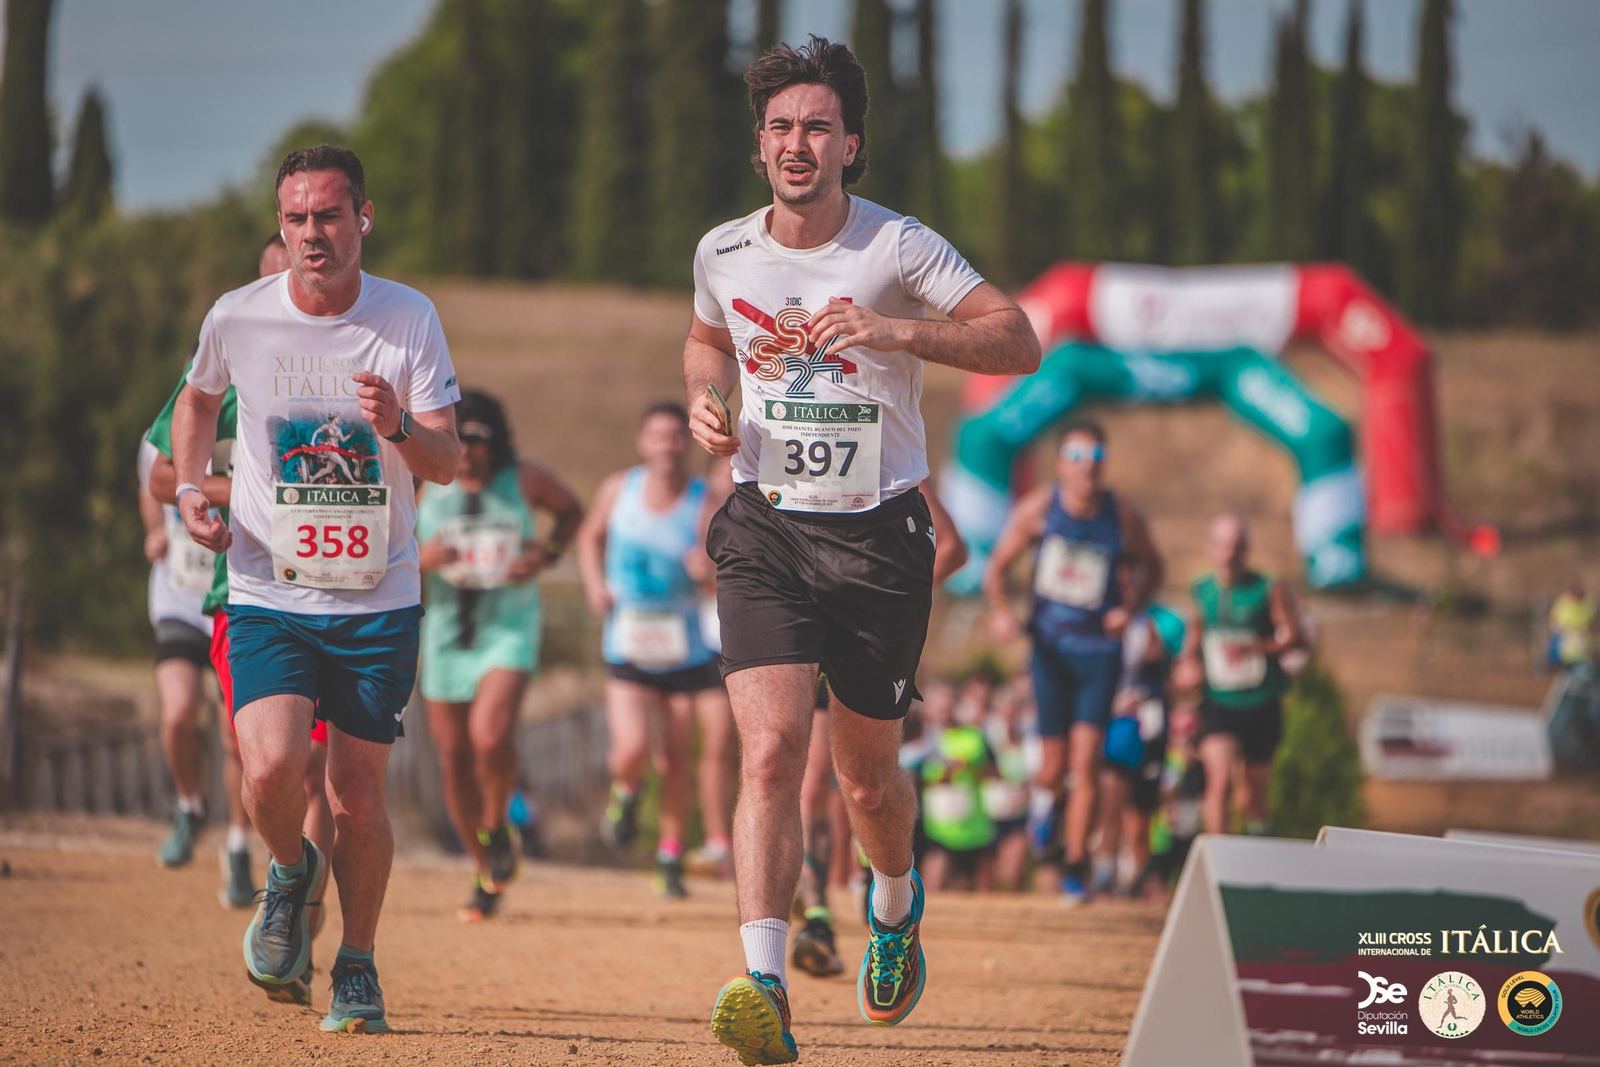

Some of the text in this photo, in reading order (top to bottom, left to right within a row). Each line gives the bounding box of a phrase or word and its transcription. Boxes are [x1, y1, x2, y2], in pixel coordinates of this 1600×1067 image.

[716, 241, 743, 256] luanvi
[275, 357, 322, 373] XLIII
[274, 371, 357, 397] ITÁLIC
[794, 404, 848, 419] ITÁLICA
[784, 439, 859, 477] 397
[306, 489, 360, 502] ITÁLICA
[296, 525, 370, 559] 358
